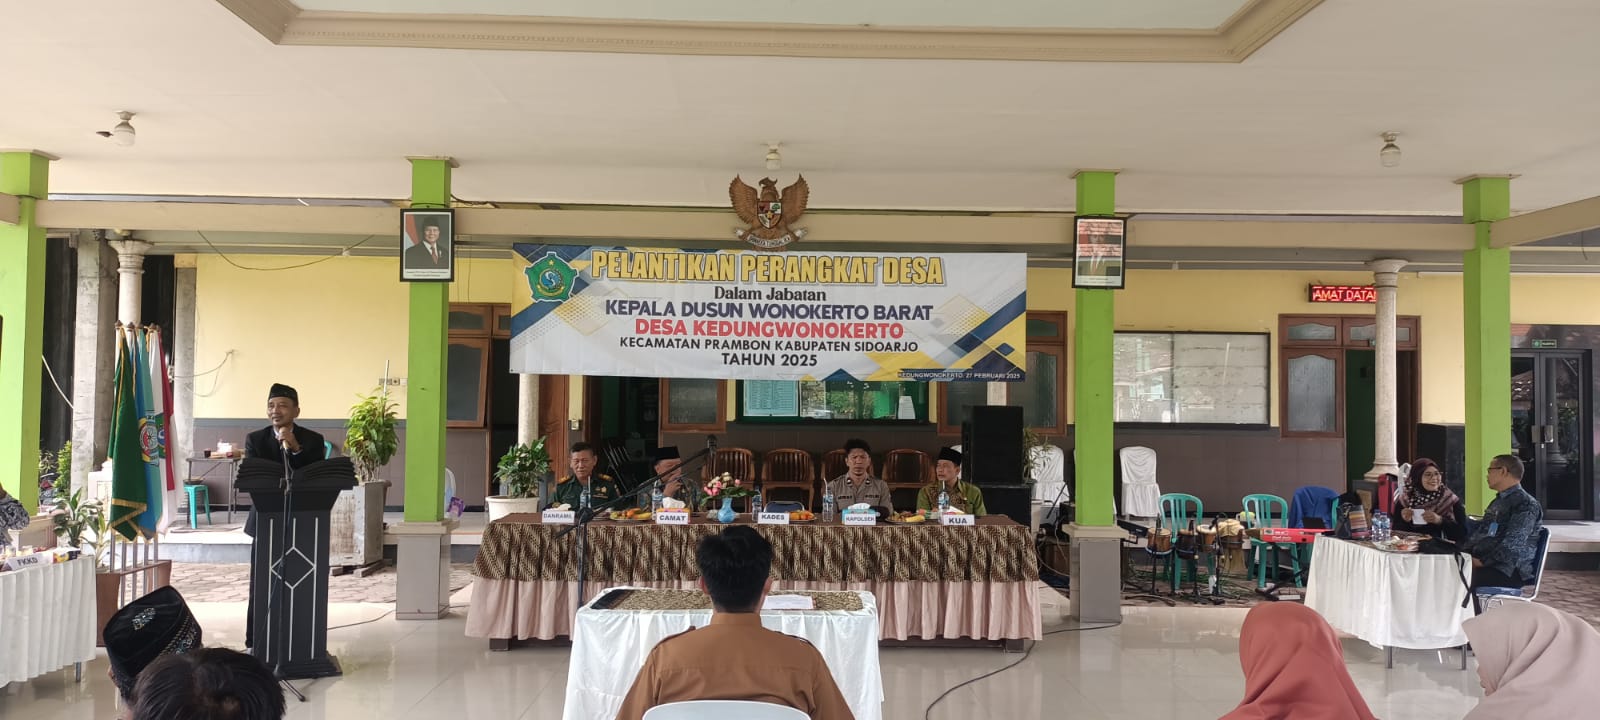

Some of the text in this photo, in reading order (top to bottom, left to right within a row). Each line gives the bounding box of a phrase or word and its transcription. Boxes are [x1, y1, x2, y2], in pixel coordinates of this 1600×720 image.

[591, 250, 945, 285] PELANTIKAN PERANGKAT DESA
[714, 285, 827, 302] Dalam Jabatan
[605, 300, 934, 321] KEPALA DUSUN WONOKERTO BARAT
[635, 319, 905, 339] DESA KEDUNGWONOKERTO
[619, 337, 919, 353] KECAMATAN PRAMBON KABUPATEN SIDOARJO
[721, 352, 818, 367] TAHUN 2025
[659, 514, 687, 522] CAMAT
[948, 517, 968, 525] KUA
